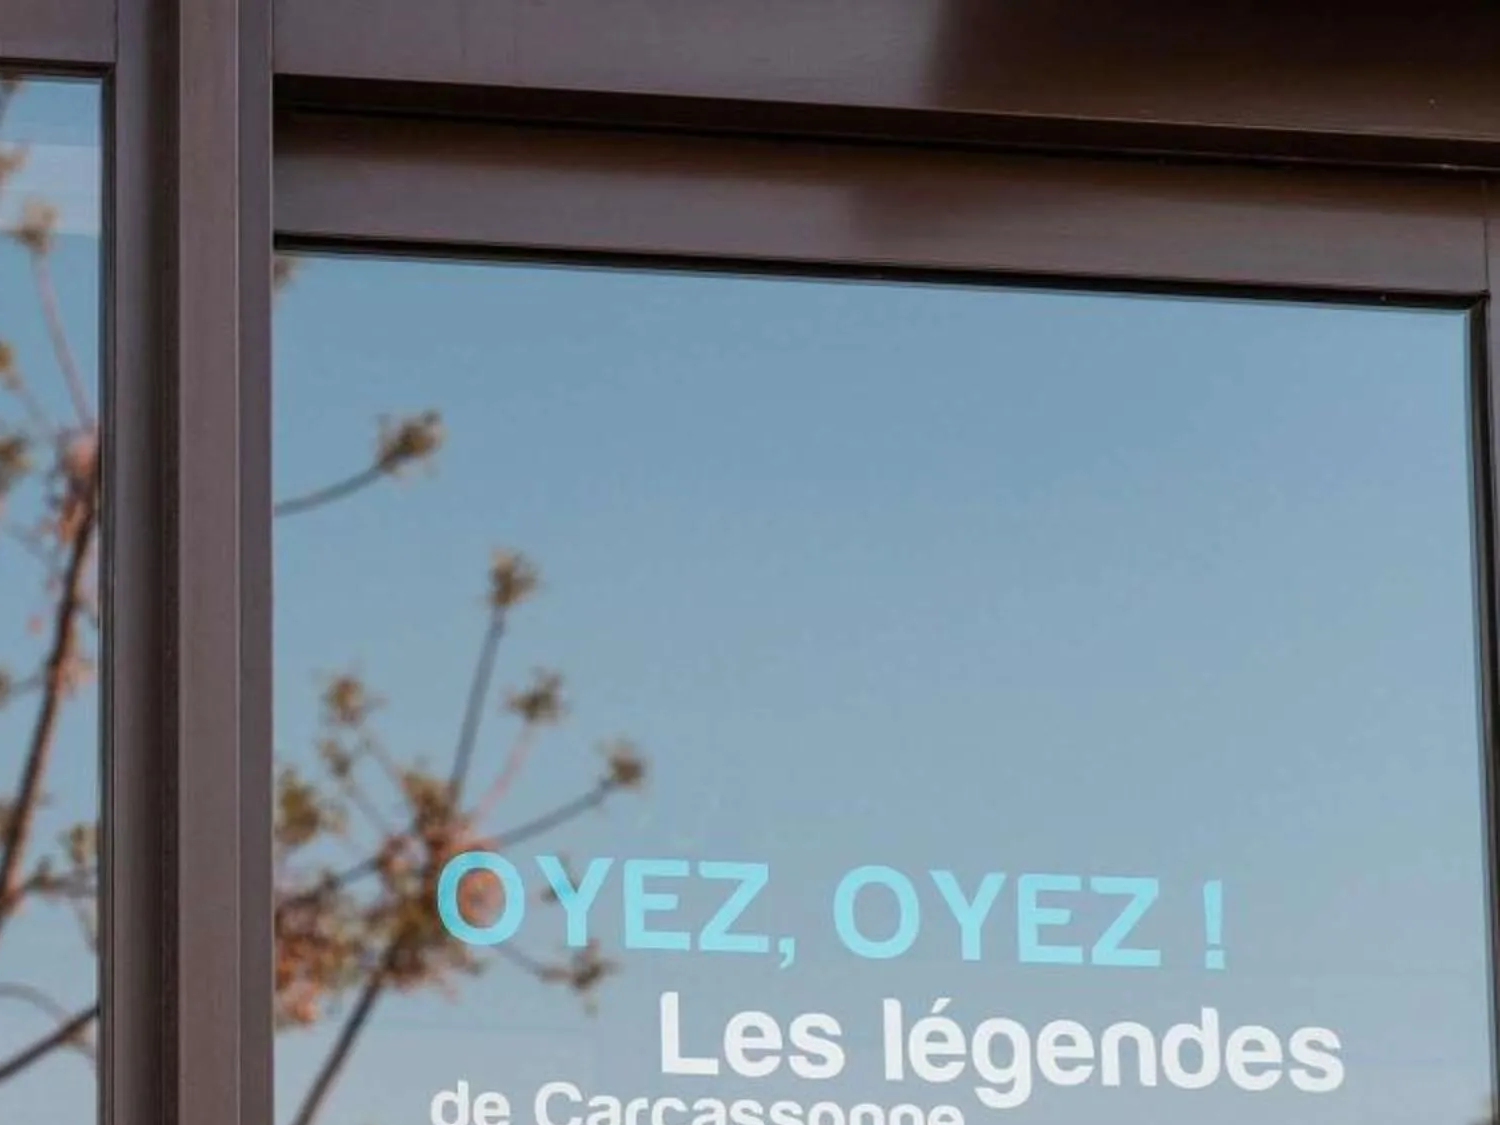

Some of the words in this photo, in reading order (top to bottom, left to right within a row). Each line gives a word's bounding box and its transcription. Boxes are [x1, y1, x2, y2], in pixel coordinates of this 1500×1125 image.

[437, 850, 796, 969] OYEZ,
[833, 864, 1162, 968] OYEZ
[1201, 879, 1226, 970] !
[659, 991, 846, 1080] Les
[882, 996, 1346, 1109] légendes
